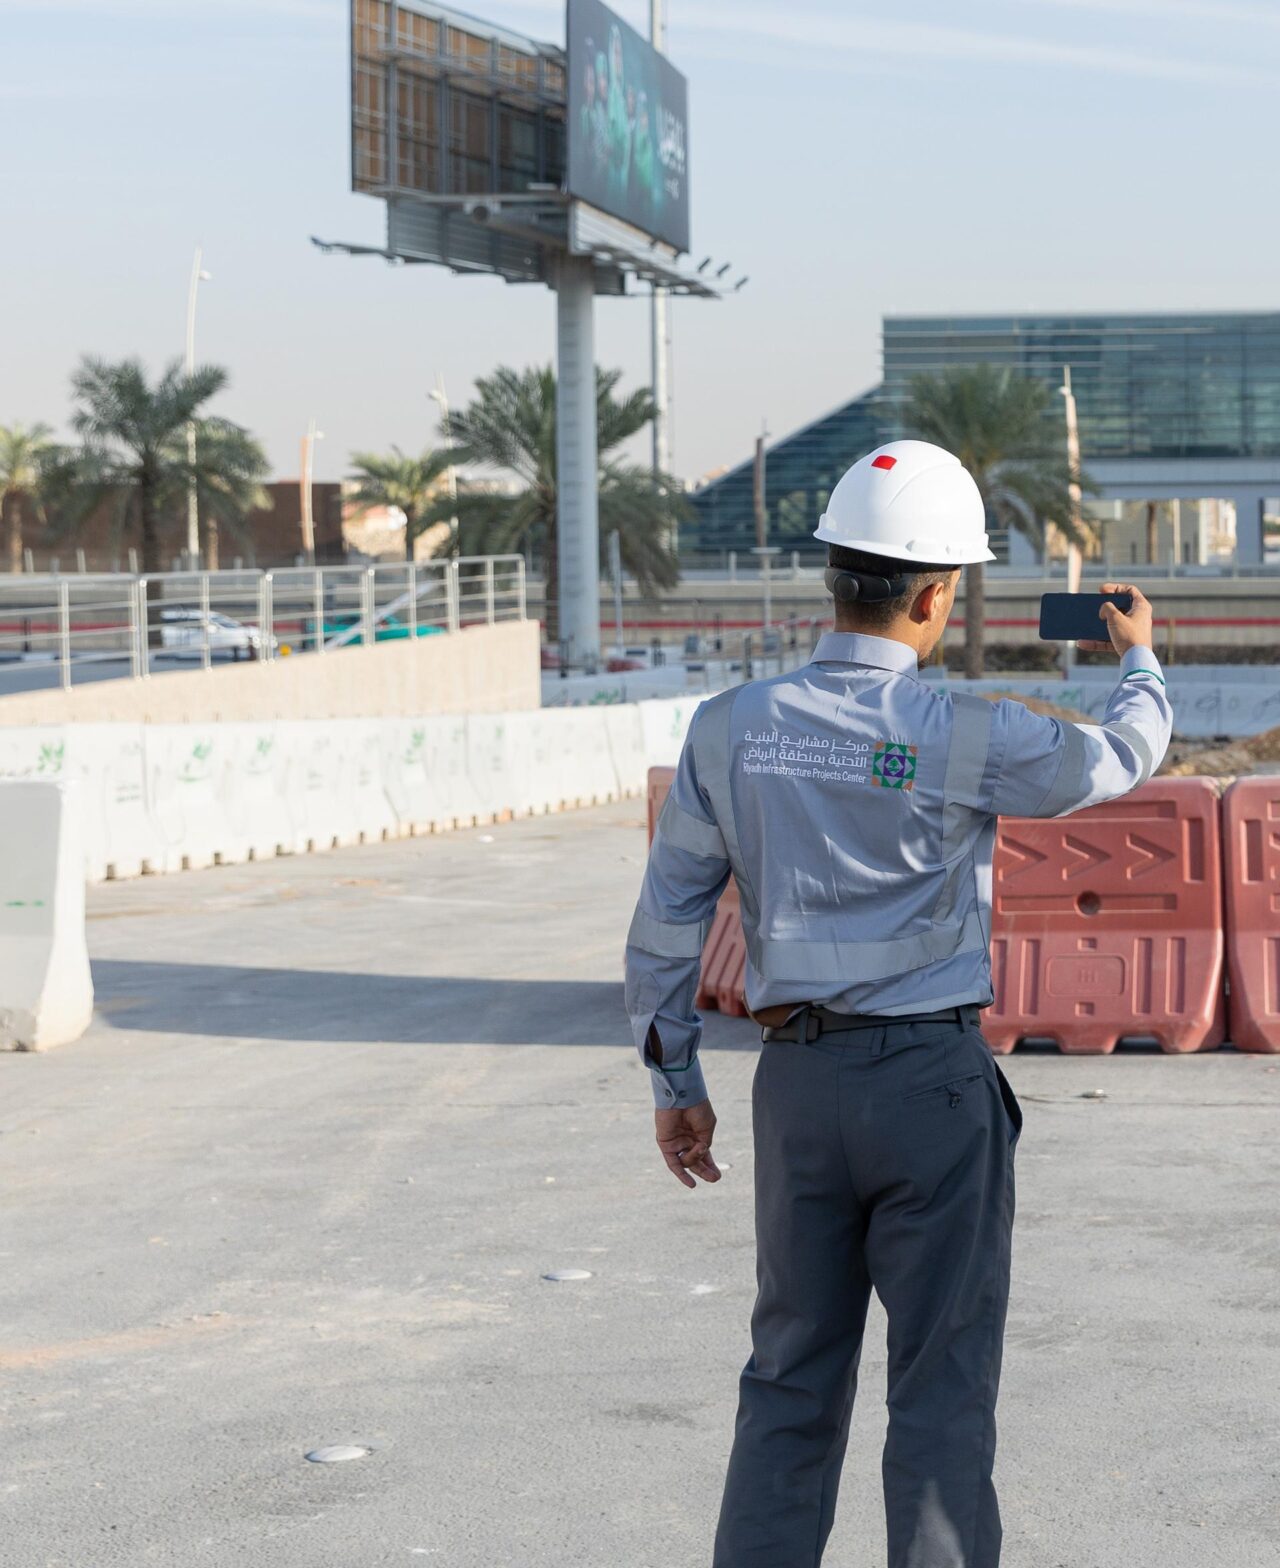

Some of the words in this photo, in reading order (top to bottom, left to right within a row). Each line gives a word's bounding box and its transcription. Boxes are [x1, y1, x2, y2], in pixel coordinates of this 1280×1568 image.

[744, 730, 778, 745] البنية
[780, 735, 830, 749] مشاريع
[743, 746, 776, 762] الرياض
[830, 738, 869, 755] مركز
[779, 748, 825, 766] بمنطقة
[828, 753, 867, 769] التحتية
[762, 763, 812, 778] Infrastructure
[812, 767, 841, 782] Projects
[842, 770, 866, 784] Center
